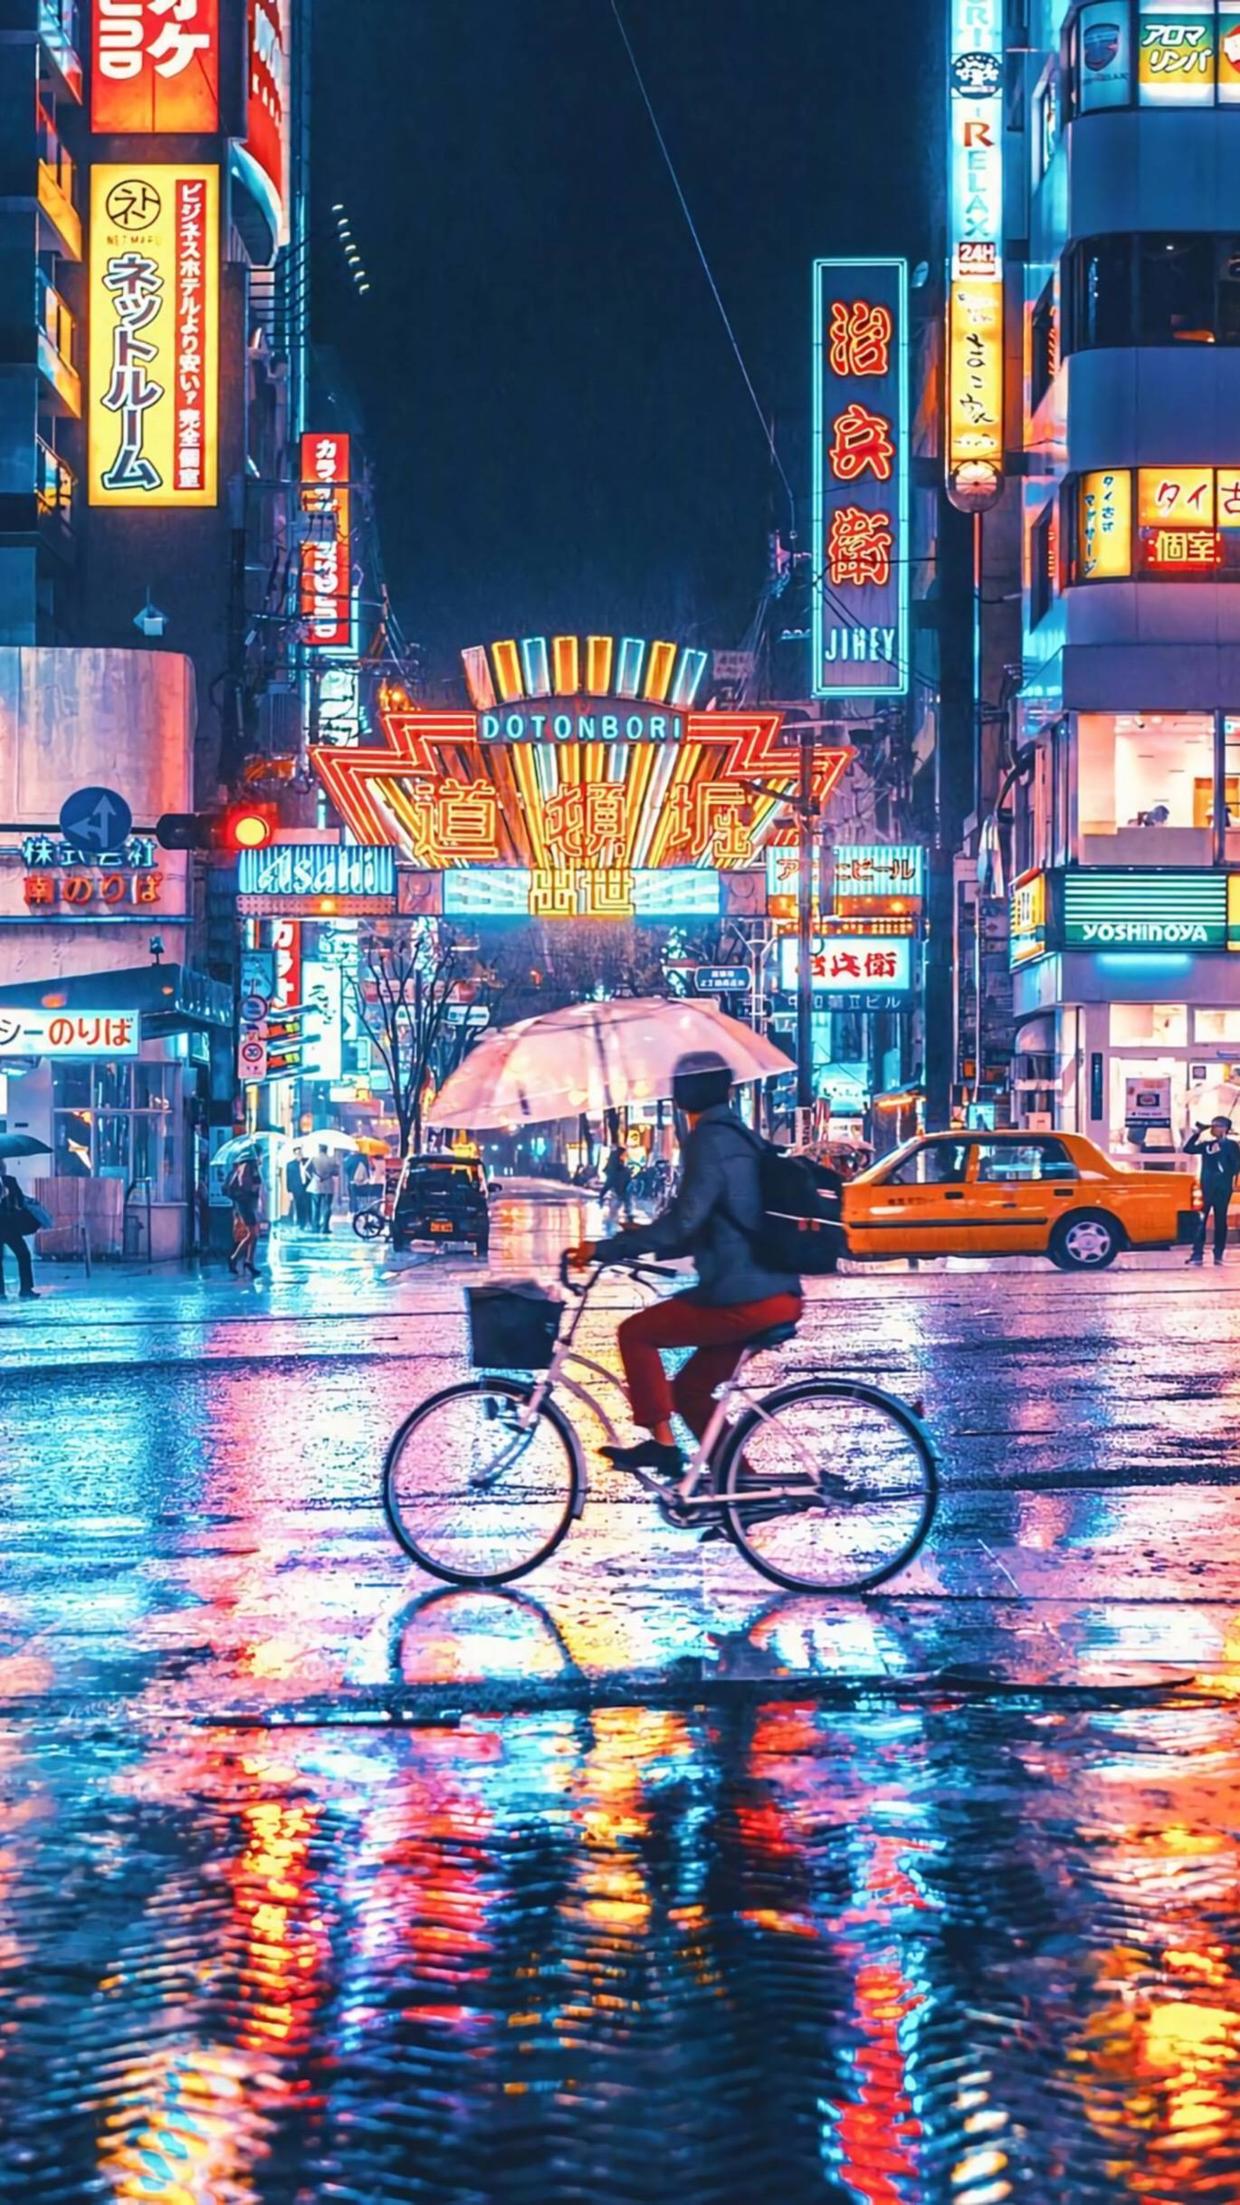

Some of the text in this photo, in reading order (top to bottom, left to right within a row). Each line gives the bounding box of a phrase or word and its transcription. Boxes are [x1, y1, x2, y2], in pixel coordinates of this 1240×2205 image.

[1142, 24, 1206, 47] アロマ
[102, 252, 164, 490] ネットルーム
[1156, 531, 1215, 562] 個室
[482, 715, 681, 739] DOTONBORI
[414, 778, 751, 859] 道頓堀
[258, 849, 375, 893] Asahi
[529, 864, 635, 915] 出世
